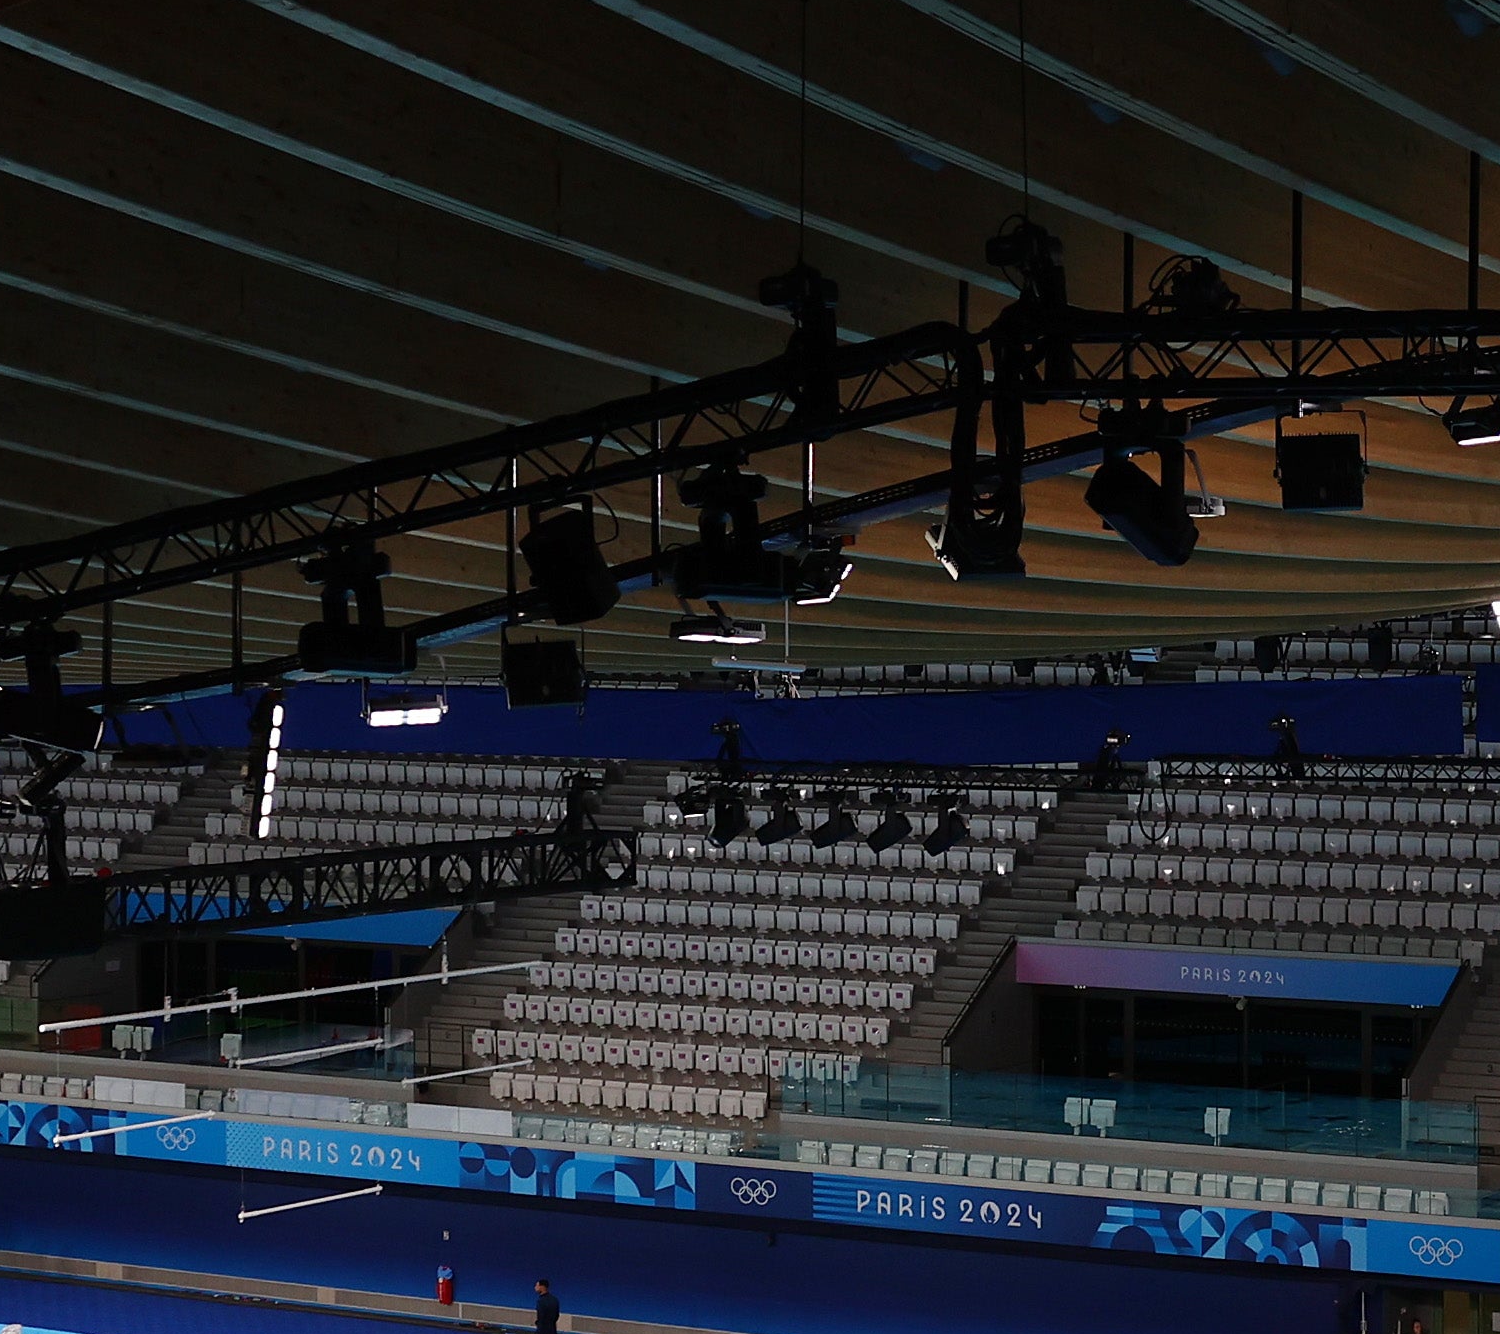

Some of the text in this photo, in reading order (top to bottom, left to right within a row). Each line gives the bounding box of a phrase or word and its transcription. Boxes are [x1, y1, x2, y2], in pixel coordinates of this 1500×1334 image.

[1238, 970, 1284, 985] 2024
[350, 1144, 421, 1171] 2024
[960, 1199, 1042, 1229] 2024
